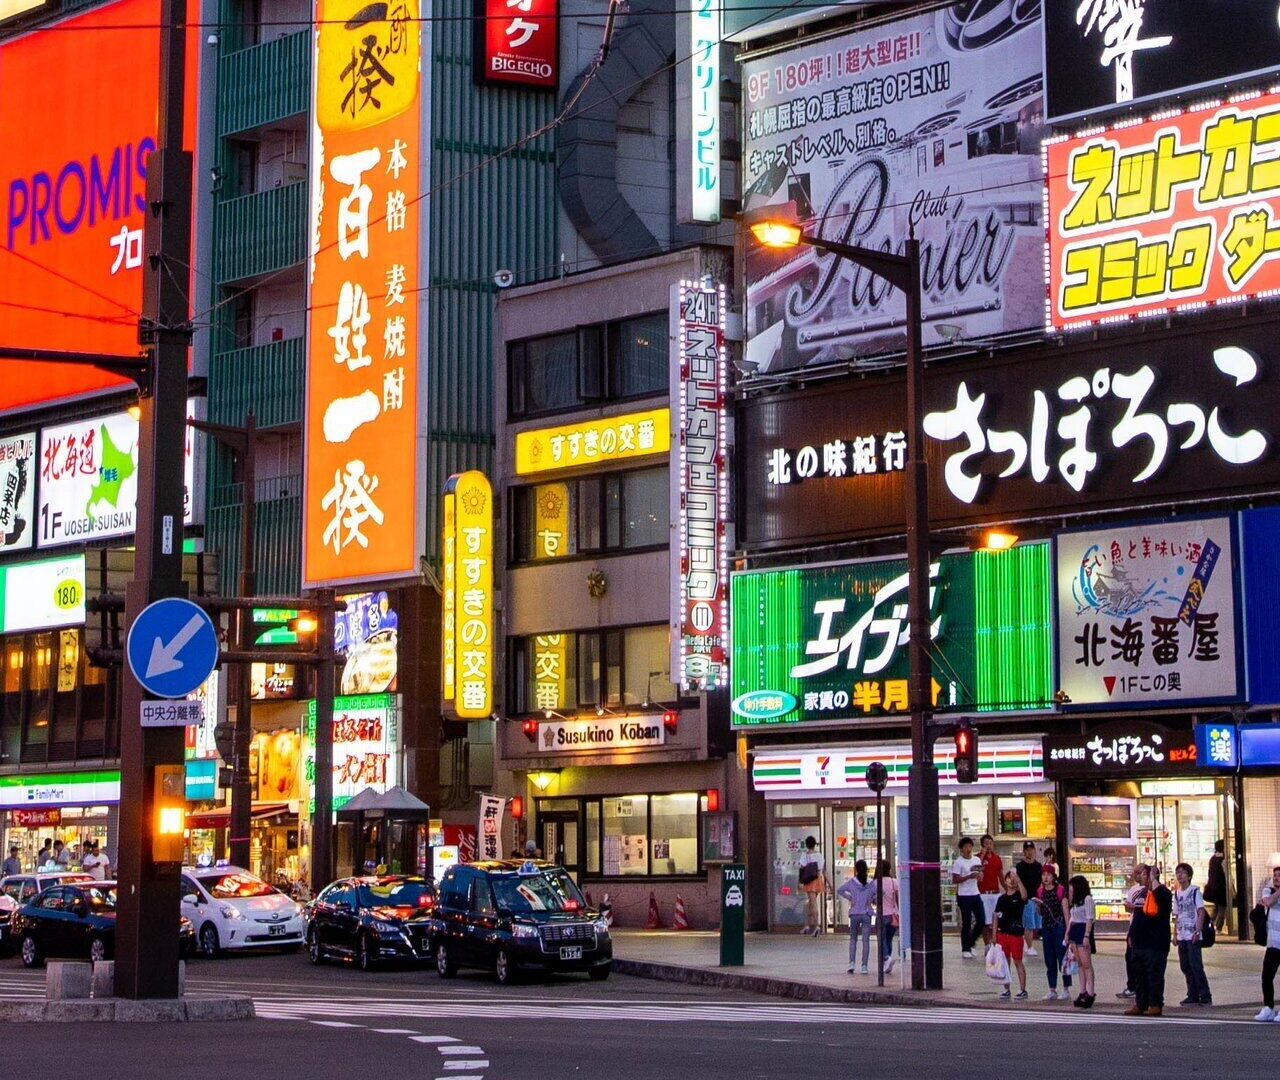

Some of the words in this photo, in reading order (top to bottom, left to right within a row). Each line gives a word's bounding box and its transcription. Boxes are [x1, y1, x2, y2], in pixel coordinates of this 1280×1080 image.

[491, 57, 515, 71] BIG
[517, 60, 553, 78] ECHO
[748, 72, 769, 102] 9F
[696, 39, 716, 191] グリーンビル
[8, 135, 157, 253] PROMIS
[385, 138, 408, 233] 本格
[908, 185, 951, 226] Club
[1060, 233, 1212, 312] コミック
[686, 292, 718, 324] 24H
[321, 147, 385, 559] 百姓一揆
[383, 263, 407, 413] 麦焼酎
[549, 418, 655, 463] すすきの交番
[923, 345, 1268, 504] さっぽろっこ
[42, 429, 97, 483] 北海道
[770, 431, 908, 485] 北の味紀行
[42, 503, 62, 540] 1F
[64, 512, 132, 537] UOSEN-SUISAN
[460, 525, 489, 711] すすきの交番
[1074, 612, 1220, 667] 北海番屋
[143, 705, 202, 722] 中央分離帯
[804, 691, 849, 710] 家賃の
[557, 725, 614, 748] Susukino
[620, 722, 660, 742] Kōban
[1087, 734, 1164, 765] さっぽろっこ
[35, 788, 64, 800] FamilyMart
[724, 869, 745, 880] TAXI
